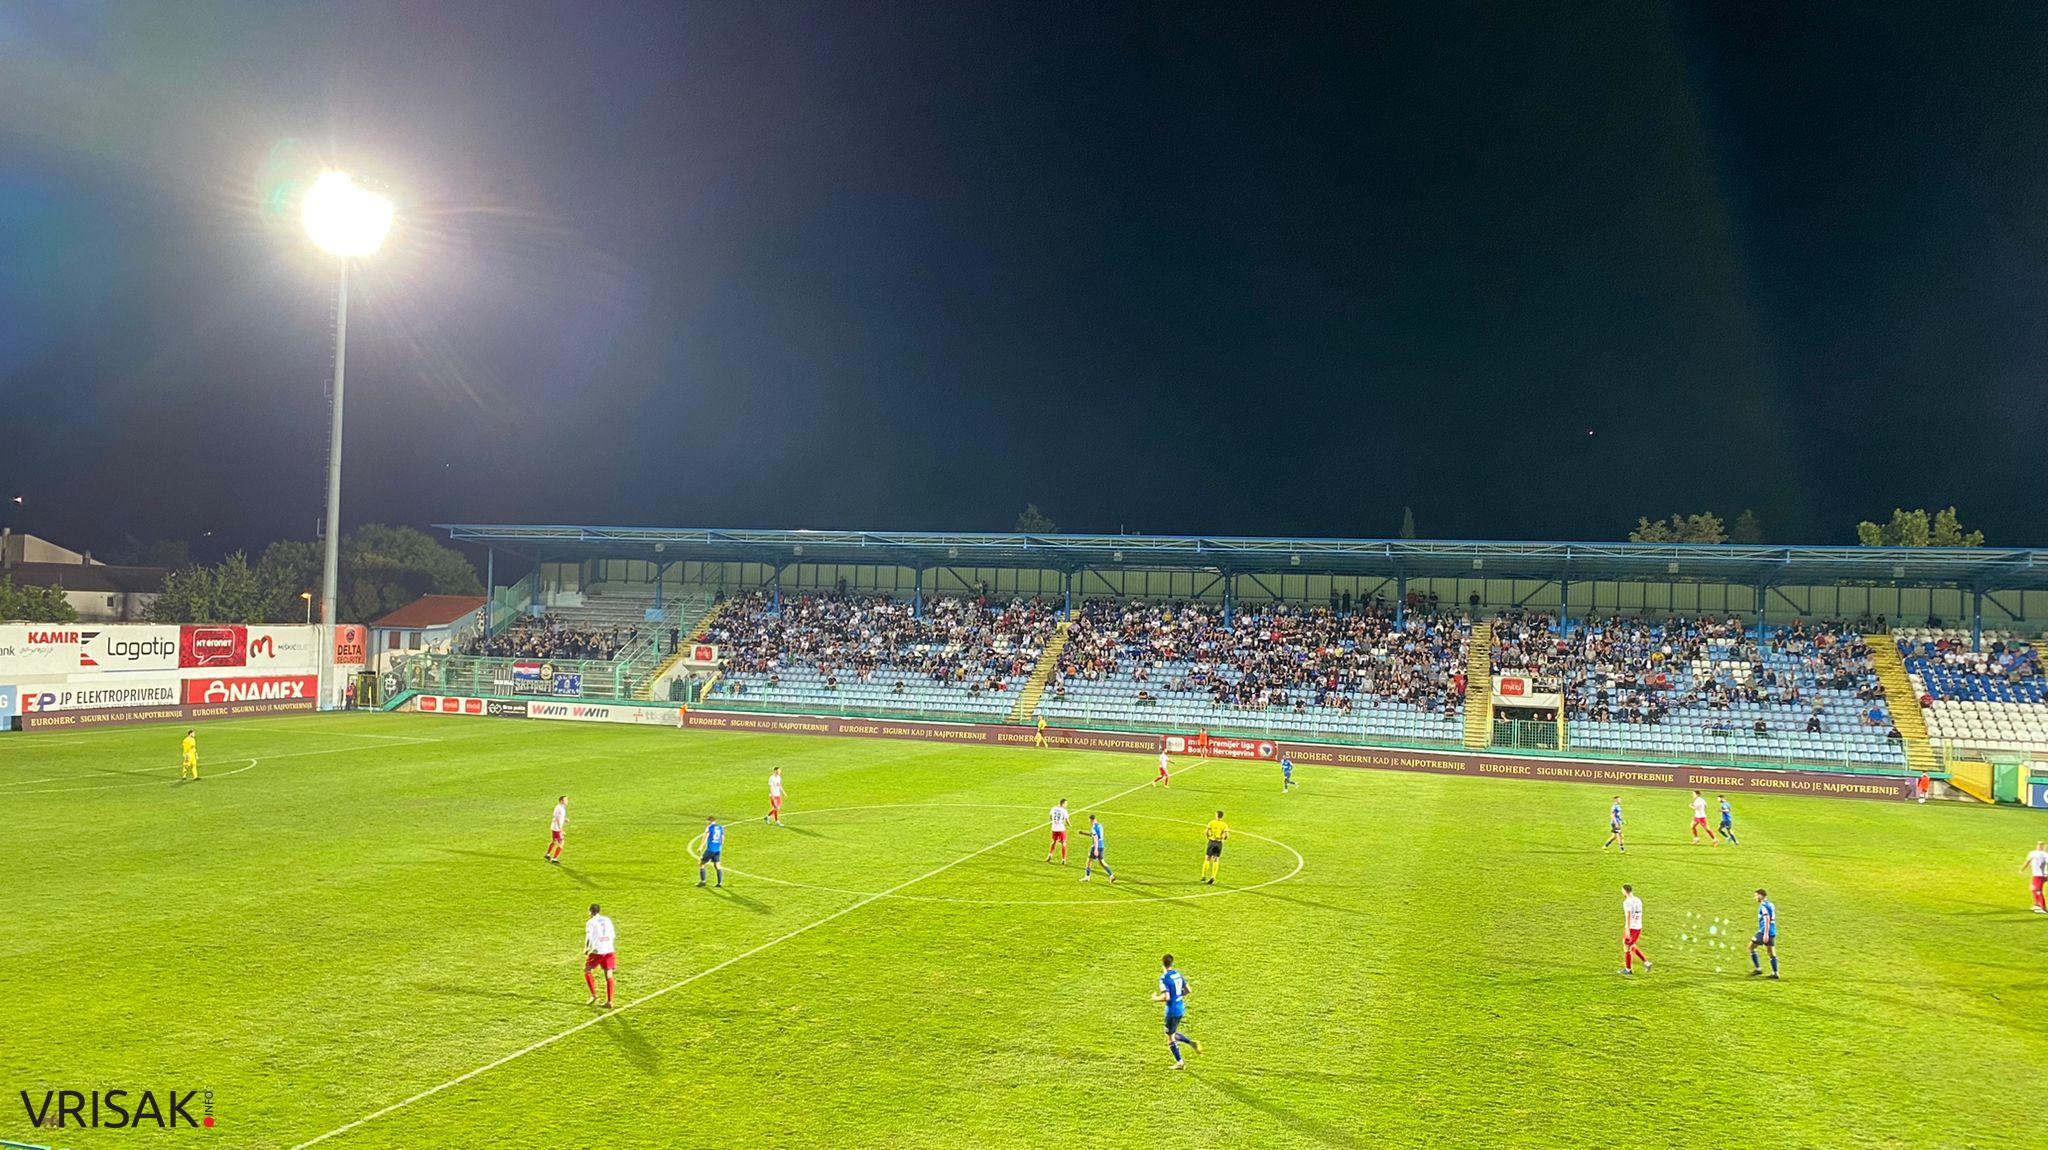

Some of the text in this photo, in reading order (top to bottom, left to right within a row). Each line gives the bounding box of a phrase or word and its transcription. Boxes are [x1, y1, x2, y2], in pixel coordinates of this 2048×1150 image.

[28, 631, 79, 644] KAMIR
[107, 637, 175, 660] Logotip
[337, 645, 362, 656] DELTA
[60, 688, 174, 705] JP ELEKTROPRIVREDA
[192, 702, 313, 717] EUROHERC SIGURNI KAD JE NAJPOTREBNIJE
[31, 710, 183, 727] EUROHERC SIGURNI KAD JE NAJPOTREBNIJE
[689, 717, 727, 726] EUROHERC
[730, 719, 756, 727] SIGURNI
[771, 721, 778, 730] JE
[778, 722, 830, 732] NAJPOTREBNIJE
[839, 725, 879, 734] EUROHERC
[882, 727, 910, 736] SIGURNI
[934, 730, 987, 740] NAJPOTREBNIJE
[1090, 738, 1098, 746] JE
[1098, 739, 1155, 750] NAJPOTREBNIJE
[1213, 748, 1255, 757] Hercegovine
[1338, 754, 1371, 764] SIGURNI
[1372, 756, 1390, 765] KAD
[1391, 758, 1400, 766] JE
[1400, 758, 1466, 771] NAJPOTREBNIJE
[1480, 764, 1674, 782] EUROHERC SIGURNI KAD JE NAJPOTREBNIJE
[1689, 775, 1900, 796] EUROHERC SIGURNI KAD JE NAJPOTREBNIJE
